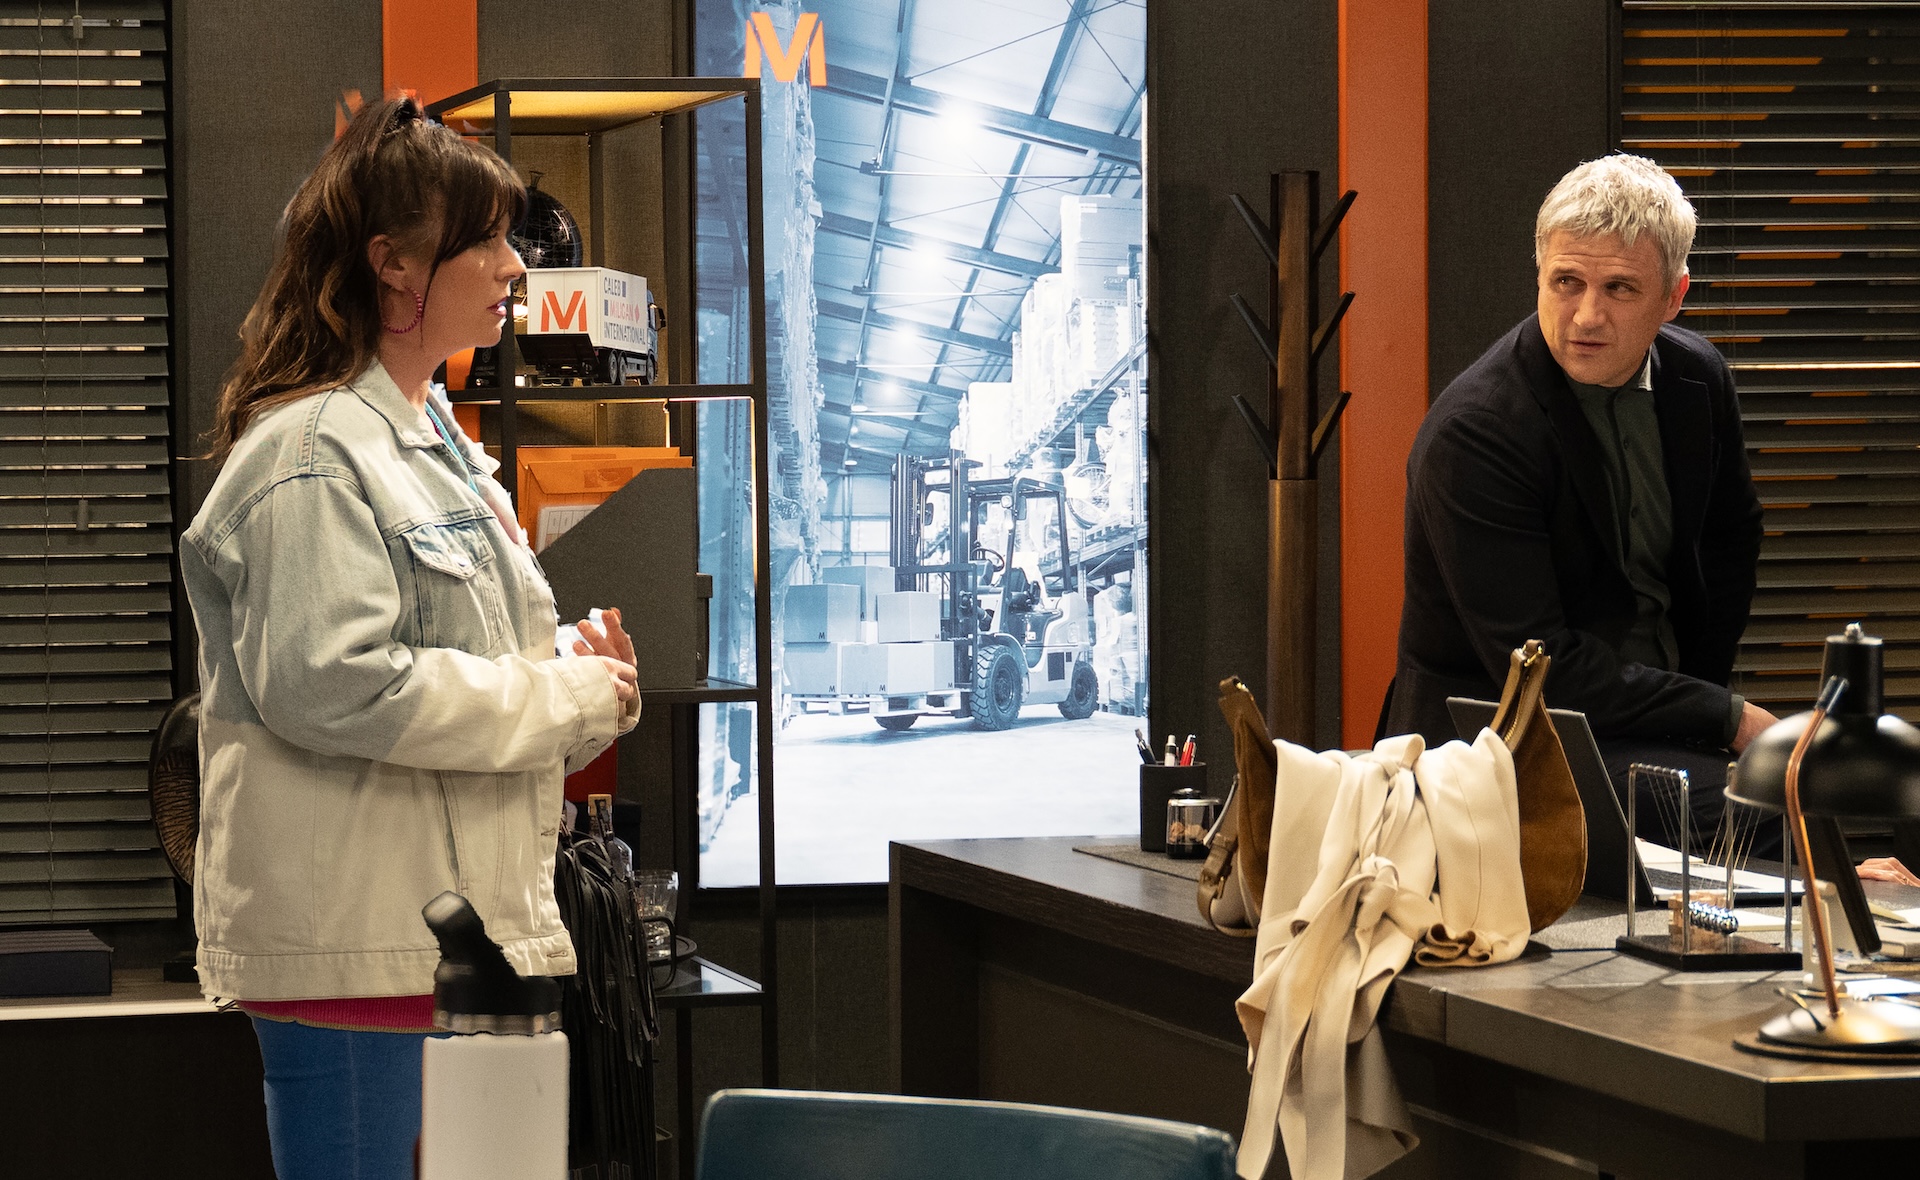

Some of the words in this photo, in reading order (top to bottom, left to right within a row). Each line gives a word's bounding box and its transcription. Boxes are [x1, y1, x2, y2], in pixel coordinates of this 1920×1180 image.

[744, 12, 827, 86] M
[604, 276, 620, 296] CALEB
[541, 291, 588, 332] M
[604, 322, 646, 345] INTERNATIONAL
